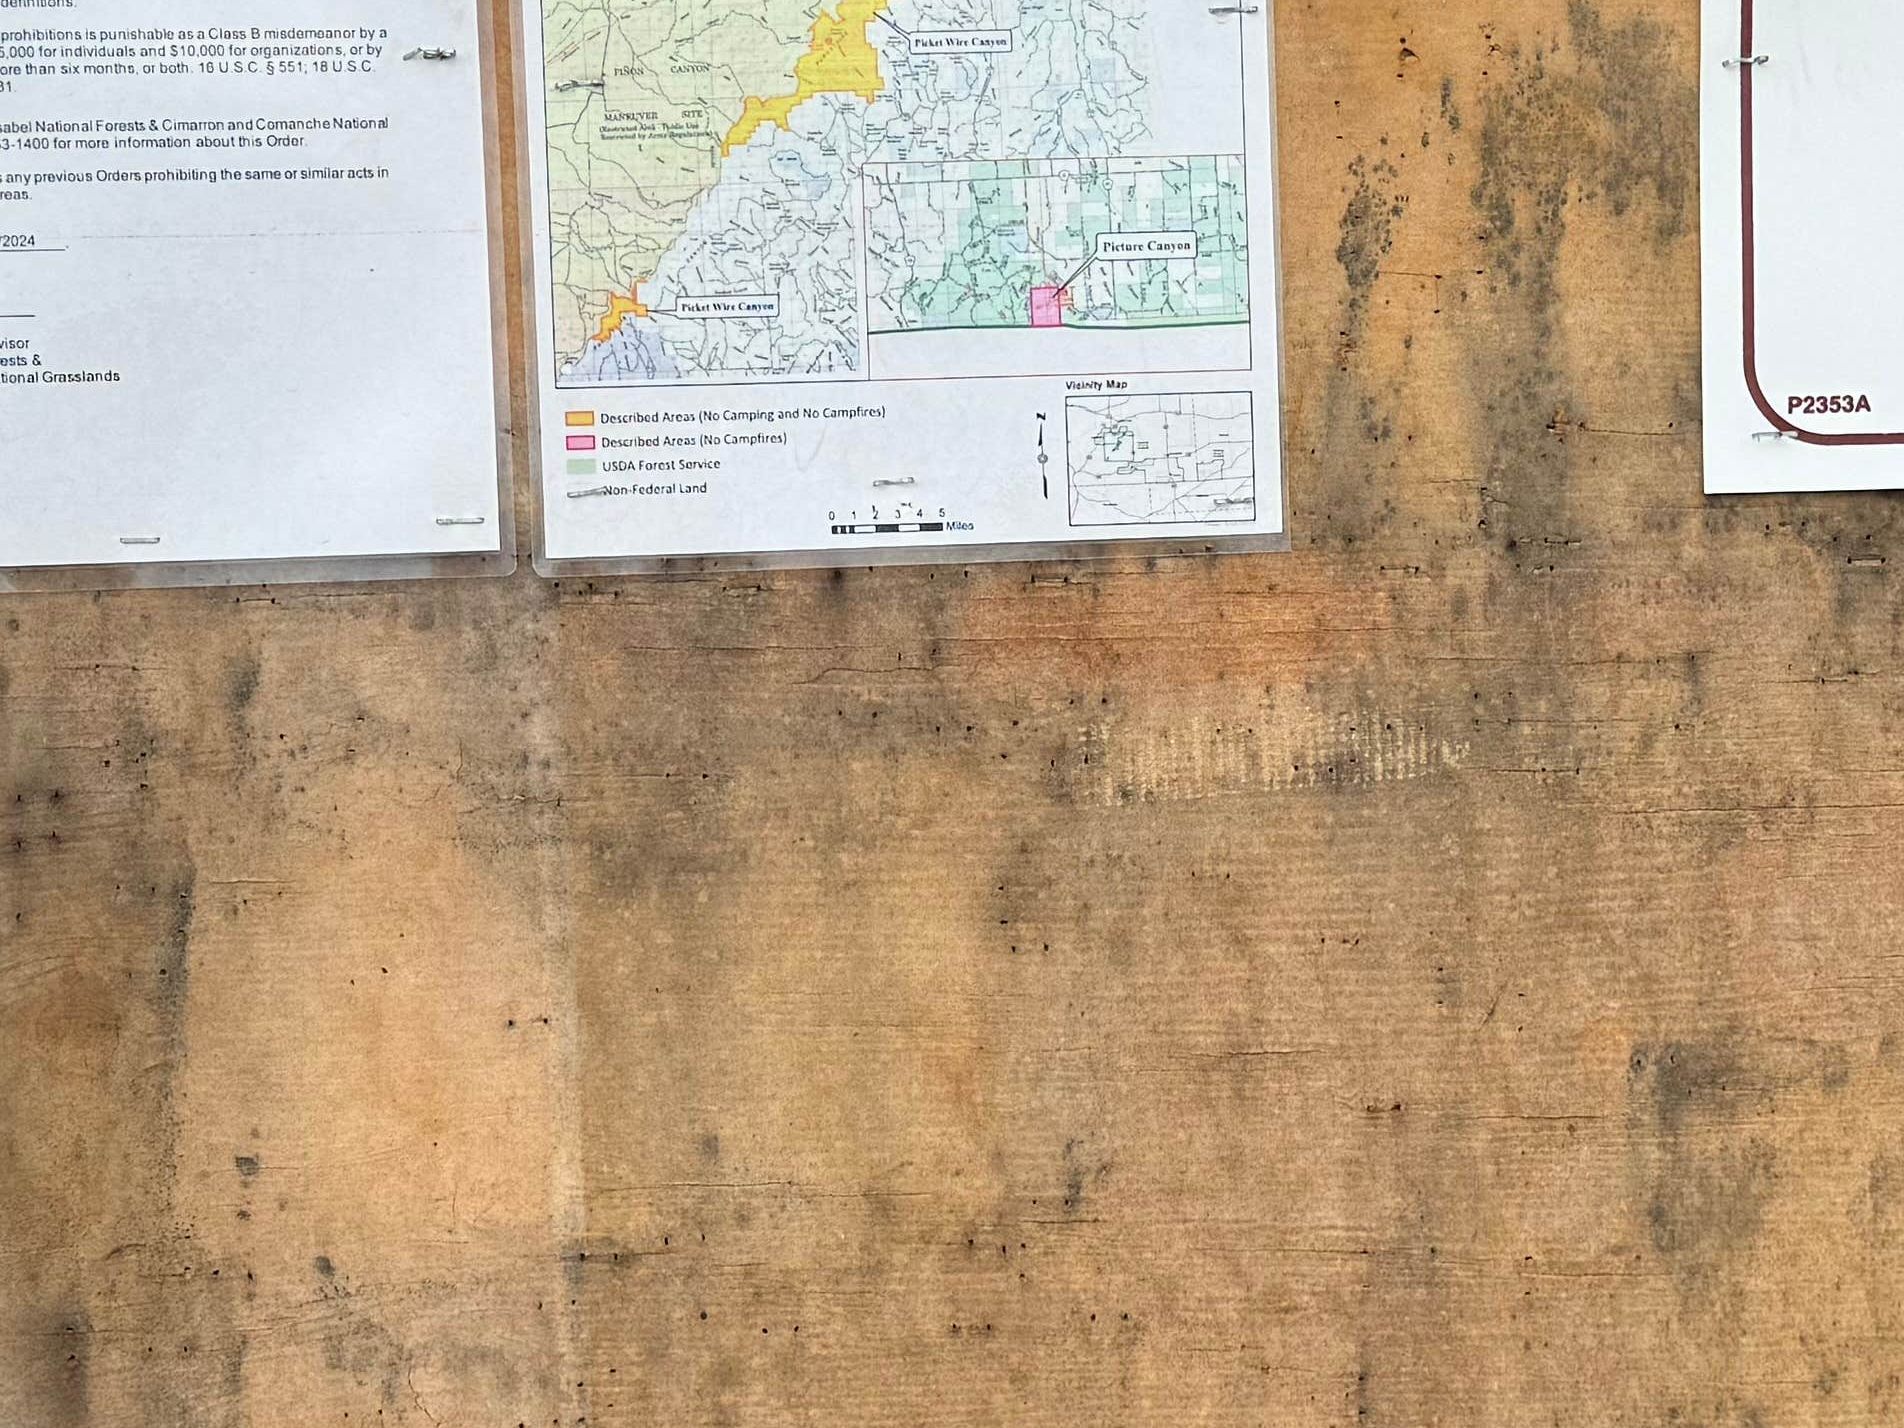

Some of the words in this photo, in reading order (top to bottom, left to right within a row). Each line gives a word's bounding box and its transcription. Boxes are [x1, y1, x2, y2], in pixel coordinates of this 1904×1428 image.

[915, 37, 944, 47] Picket
[945, 36, 969, 47] Wire
[971, 36, 1008, 48] Canyon
[1103, 241, 1144, 252] Picture
[1147, 240, 1191, 253] Canyon
[1066, 380, 1103, 391] Vicinity
[1106, 379, 1128, 389] Map
[1788, 393, 1872, 414] P2353A
[601, 411, 660, 424] Described
[663, 411, 696, 422] Areas
[699, 410, 721, 424] (No
[723, 408, 775, 422] Camping
[778, 407, 800, 419] and
[803, 407, 820, 419] No
[823, 404, 886, 419] Campfires)
[603, 459, 636, 472] USDA
[639, 459, 676, 470] Forest
[679, 458, 721, 470] Service
